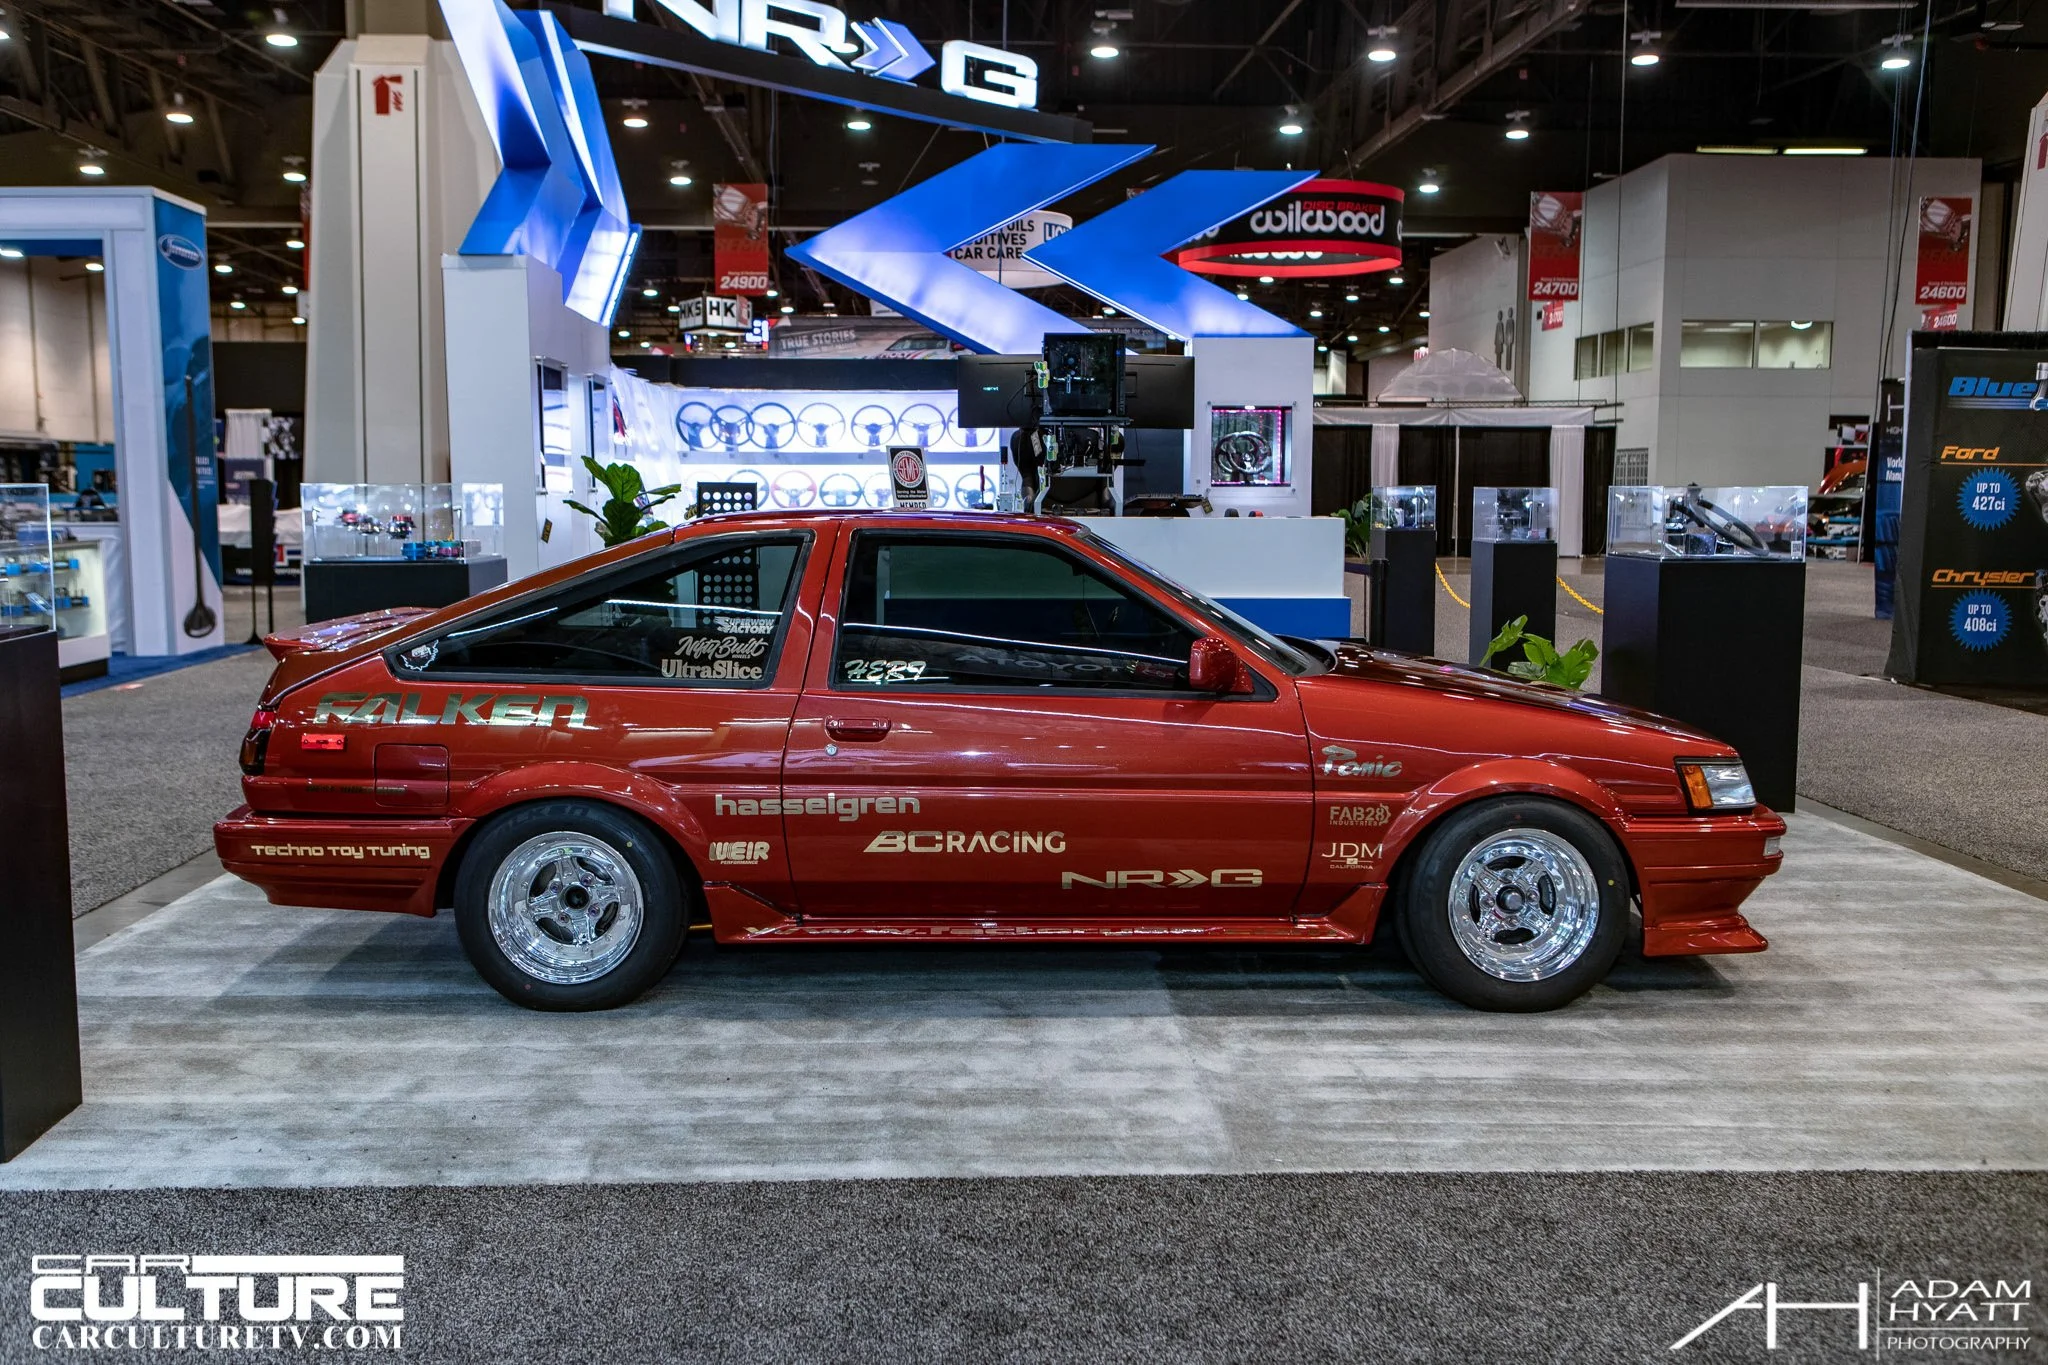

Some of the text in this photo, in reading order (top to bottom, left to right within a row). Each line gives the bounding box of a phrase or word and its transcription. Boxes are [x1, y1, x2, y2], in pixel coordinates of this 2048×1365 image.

[1250, 200, 1385, 236] wilwood
[967, 233, 1027, 246] DITIVES
[954, 247, 1023, 260] CAR CARE
[720, 276, 768, 289] 24900
[1533, 282, 1578, 295] 24700
[1920, 286, 1966, 299] 24600
[680, 302, 703, 316] HKS
[781, 337, 811, 350] TRUE
[812, 330, 857, 345] STORIES
[1948, 377, 2038, 397] Blue
[1941, 446, 2000, 461] Ford
[899, 457, 920, 482] SEMA
[1977, 483, 2000, 493] UP TO
[1972, 496, 2005, 510] 427ci
[1932, 568, 2035, 585] Chrysler
[1968, 604, 1992, 615] UP TO
[1964, 618, 1997, 632] 408ci
[661, 659, 763, 680] UltraSlice
[715, 793, 920, 822] hasselgren
[1330, 806, 1386, 821] FAB28
[708, 841, 770, 861] WEIR
[1321, 842, 1384, 859] JDM
